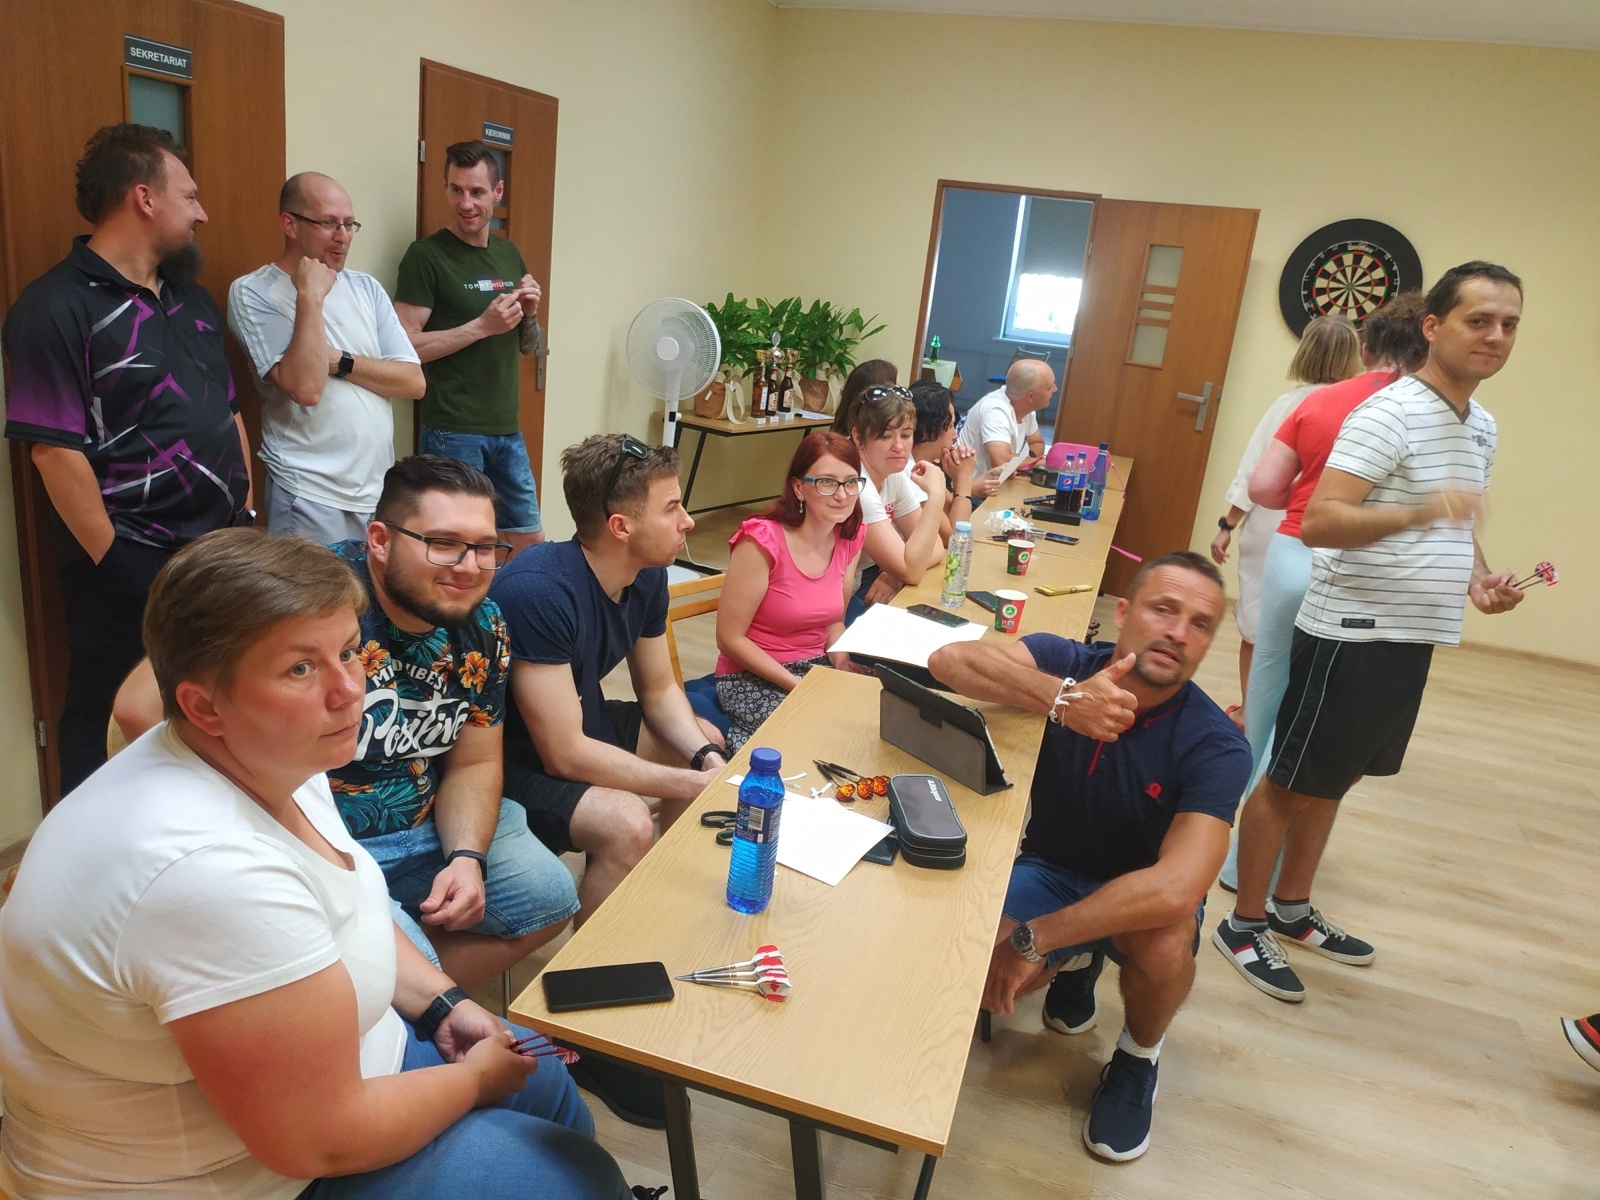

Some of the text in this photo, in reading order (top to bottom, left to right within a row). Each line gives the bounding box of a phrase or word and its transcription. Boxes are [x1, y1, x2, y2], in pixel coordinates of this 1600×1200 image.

[130, 46, 187, 68] SEKRETARIAT
[371, 658, 403, 688] MID
[352, 688, 469, 761] Positive
